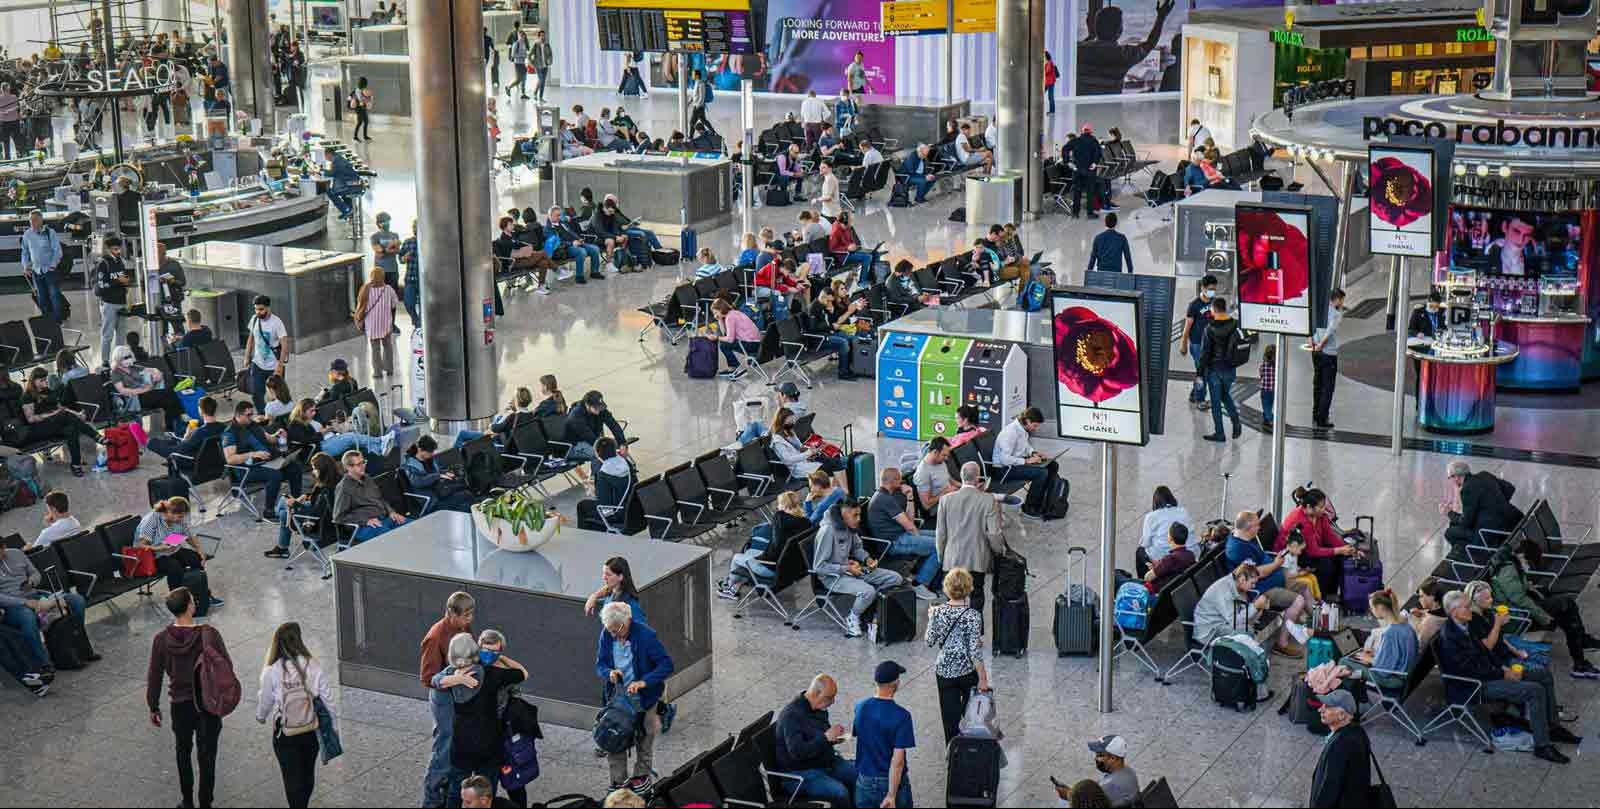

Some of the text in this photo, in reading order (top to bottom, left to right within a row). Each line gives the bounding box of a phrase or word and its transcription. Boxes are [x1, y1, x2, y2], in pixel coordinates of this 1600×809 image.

[783, 17, 823, 29] LOOKING
[825, 19, 870, 31] FORWARD
[791, 30, 885, 42] MORE ADVENTURES
[1273, 31, 1305, 46] ROLEX
[1297, 62, 1322, 72] ROLEX
[1363, 116, 1447, 140] paco
[1259, 317, 1289, 326] CHANEL
[1083, 424, 1119, 434] CHANEL
